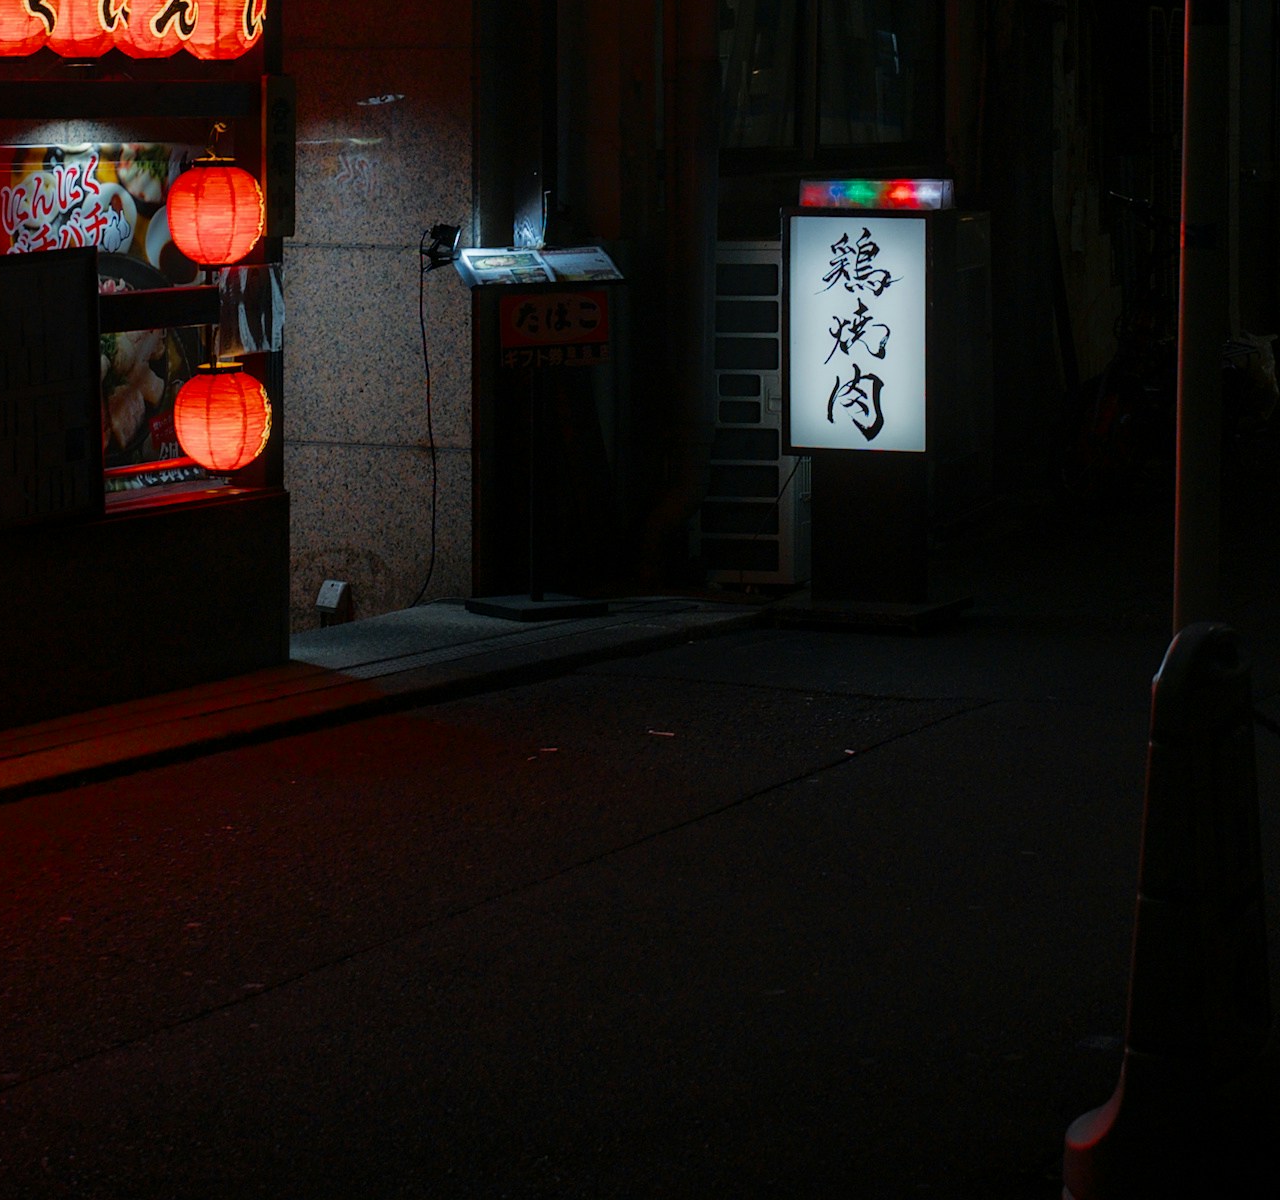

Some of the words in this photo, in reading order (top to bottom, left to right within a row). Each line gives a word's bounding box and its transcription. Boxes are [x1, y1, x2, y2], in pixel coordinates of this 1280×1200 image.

[1, 152, 101, 235] にんにく
[515, 300, 598, 333] たばこ
[814, 227, 905, 441] 鶏焼肉
